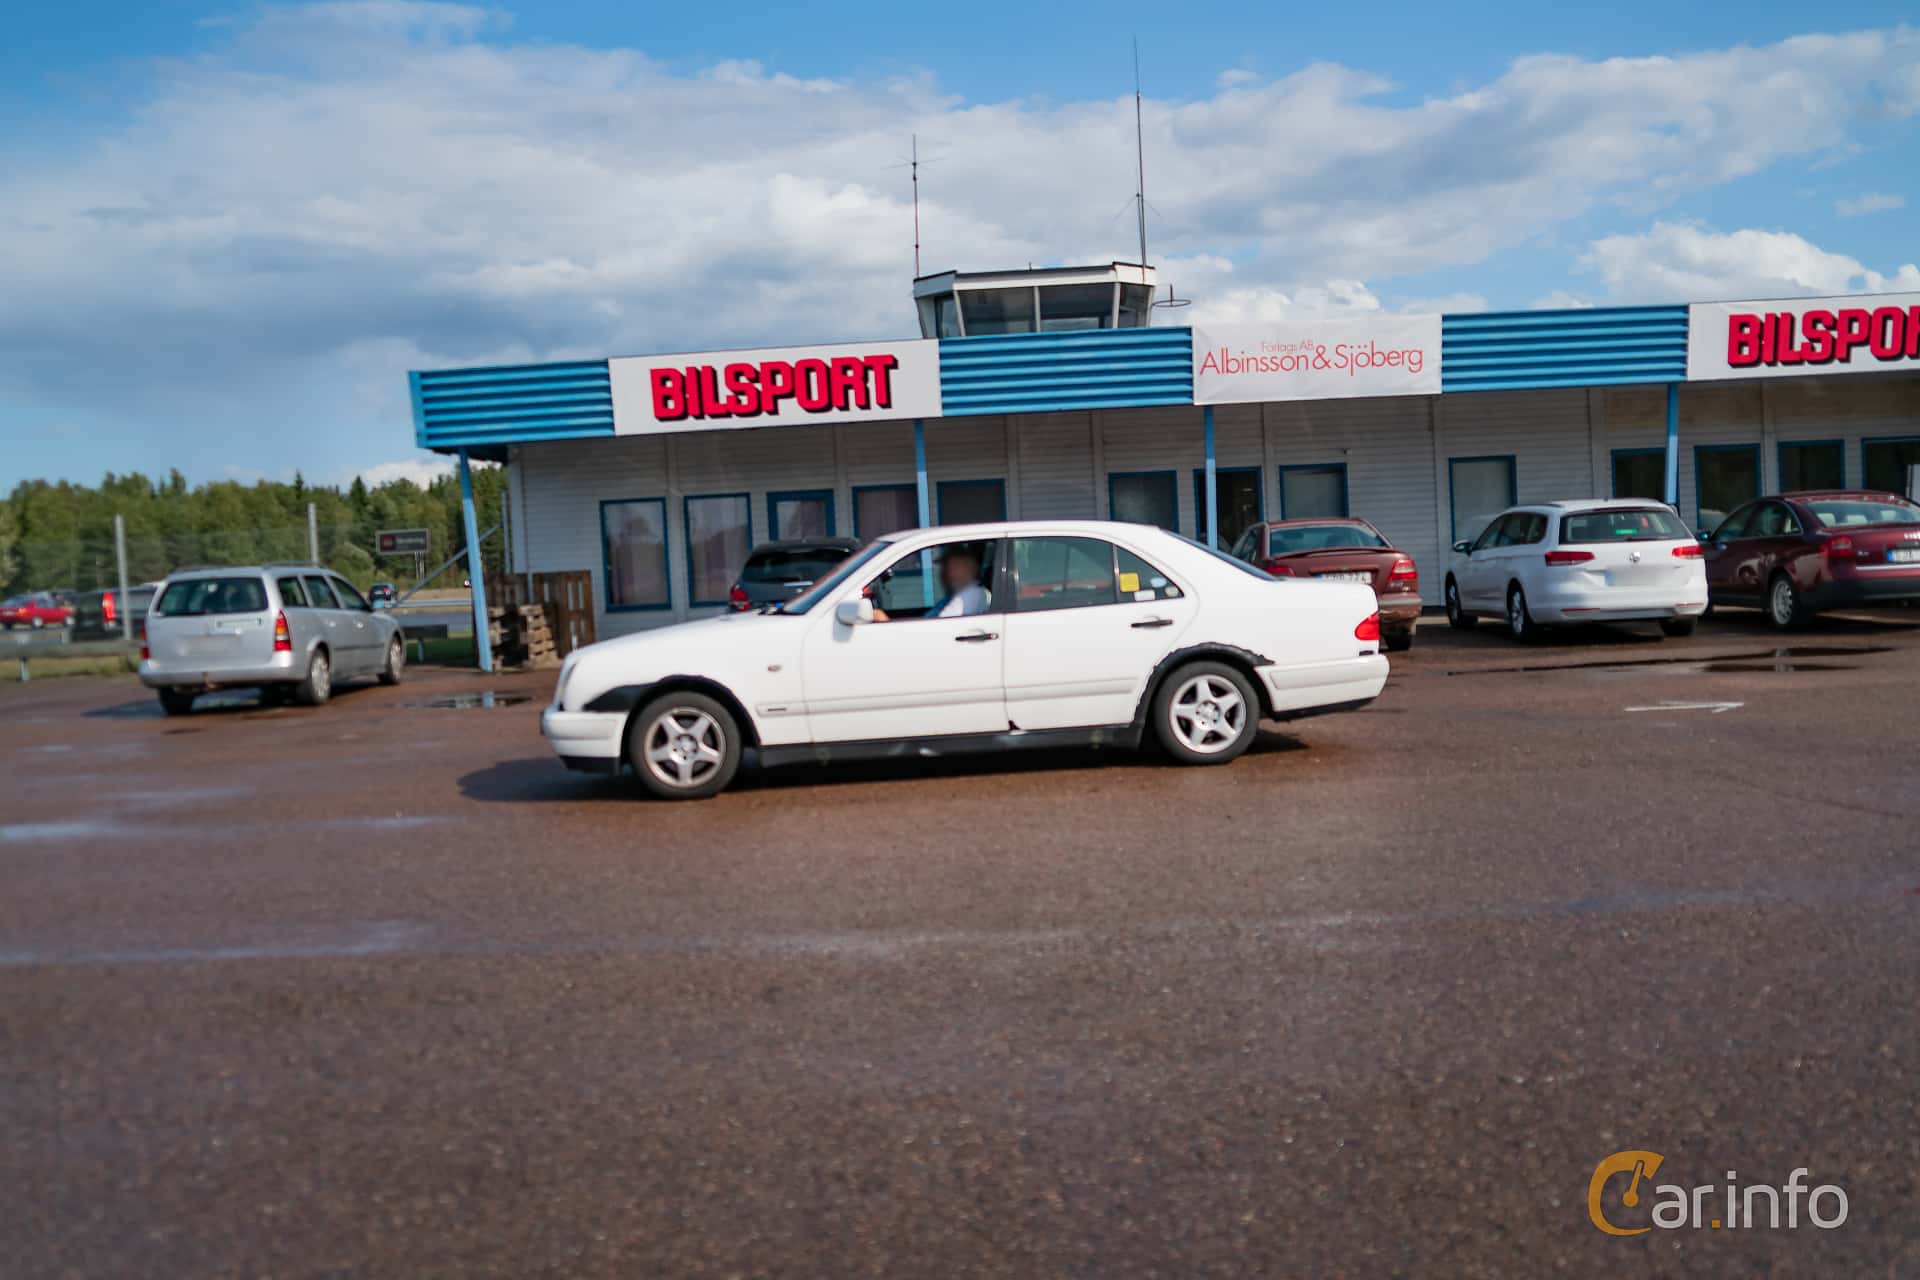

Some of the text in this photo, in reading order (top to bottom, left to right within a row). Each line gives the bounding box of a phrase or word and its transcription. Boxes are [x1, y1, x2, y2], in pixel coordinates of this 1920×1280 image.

[1199, 347, 1309, 375] Albinsson
[1334, 340, 1424, 376] Sjöberg
[650, 354, 899, 422] BILSPORT
